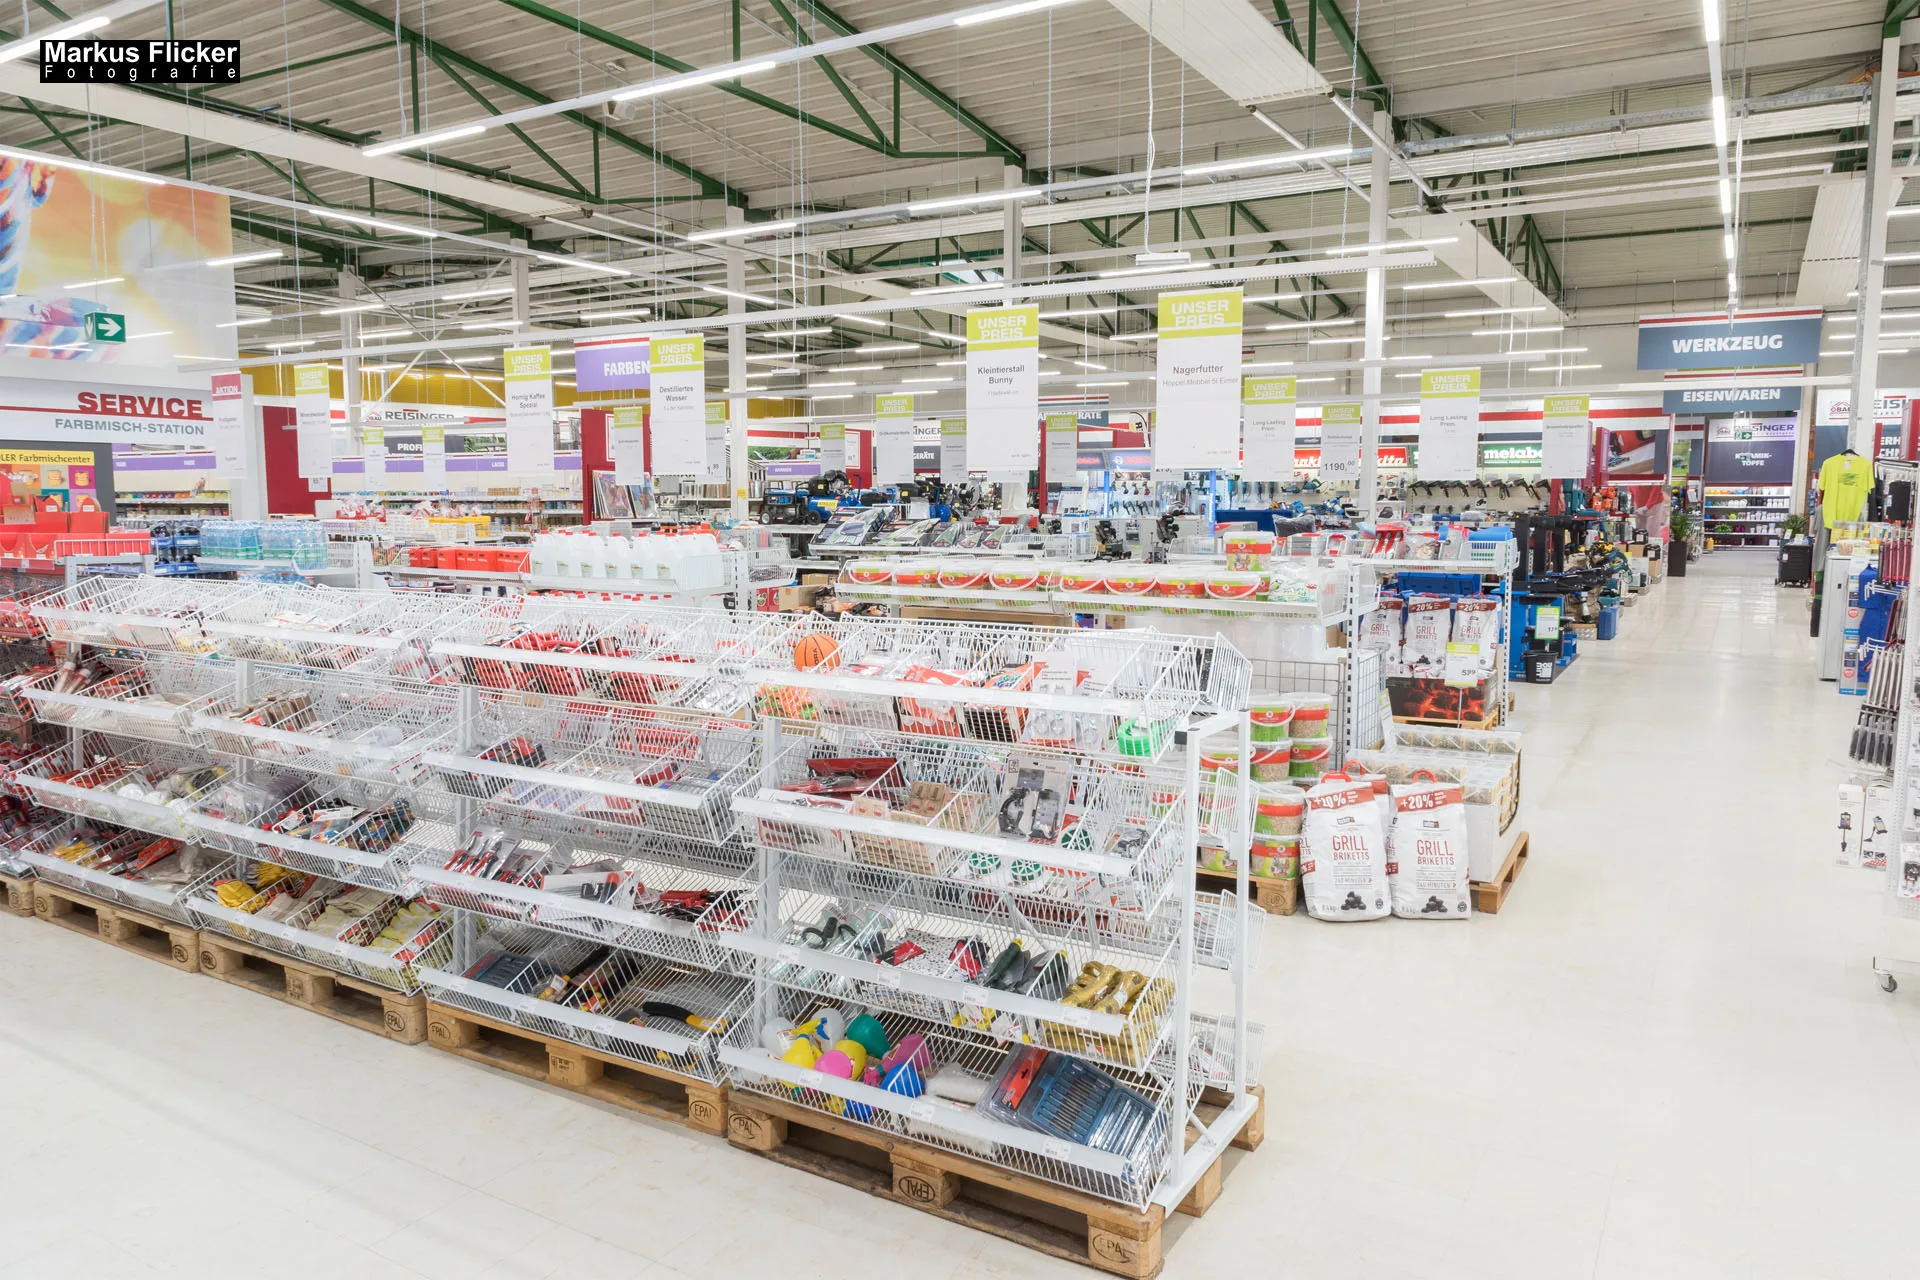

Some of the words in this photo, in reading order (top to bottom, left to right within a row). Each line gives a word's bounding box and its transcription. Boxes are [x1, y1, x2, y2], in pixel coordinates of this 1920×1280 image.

[1171, 299, 1229, 315] UNSER
[977, 314, 1027, 329] UNSER
[1175, 312, 1225, 328] PREIS
[980, 327, 1024, 341] PREIS
[657, 343, 695, 355] UNSER
[1672, 334, 1783, 354] WERKZEUG
[511, 354, 544, 364] UNSER
[660, 353, 692, 364] PREIS
[604, 361, 650, 376] FARBEN
[977, 365, 1025, 375] Kleintierstall
[1172, 364, 1224, 376] Nagerfutter
[988, 376, 1014, 386] Bunny
[1430, 374, 1471, 384] UNSER
[659, 386, 694, 394] Destilliertes
[1252, 382, 1288, 392] UNSER
[1432, 383, 1467, 392] PREIS
[665, 394, 688, 402] Wasser
[1254, 390, 1286, 399] PREIS
[1682, 387, 1781, 402] EISENWAREN
[77, 391, 203, 418] SERVICE
[54, 418, 205, 436] FARBMISCH-STATION
[18, 453, 91, 464] Farbmischcenter
[1416, 625, 1437, 635] GRILL
[1332, 835, 1368, 851] GRILL
[1416, 839, 1453, 856] GRILL
[1333, 851, 1370, 861] BRIKETTS
[1417, 856, 1455, 866] BRIKETTS
[906, 1178, 930, 1201] EPAL
